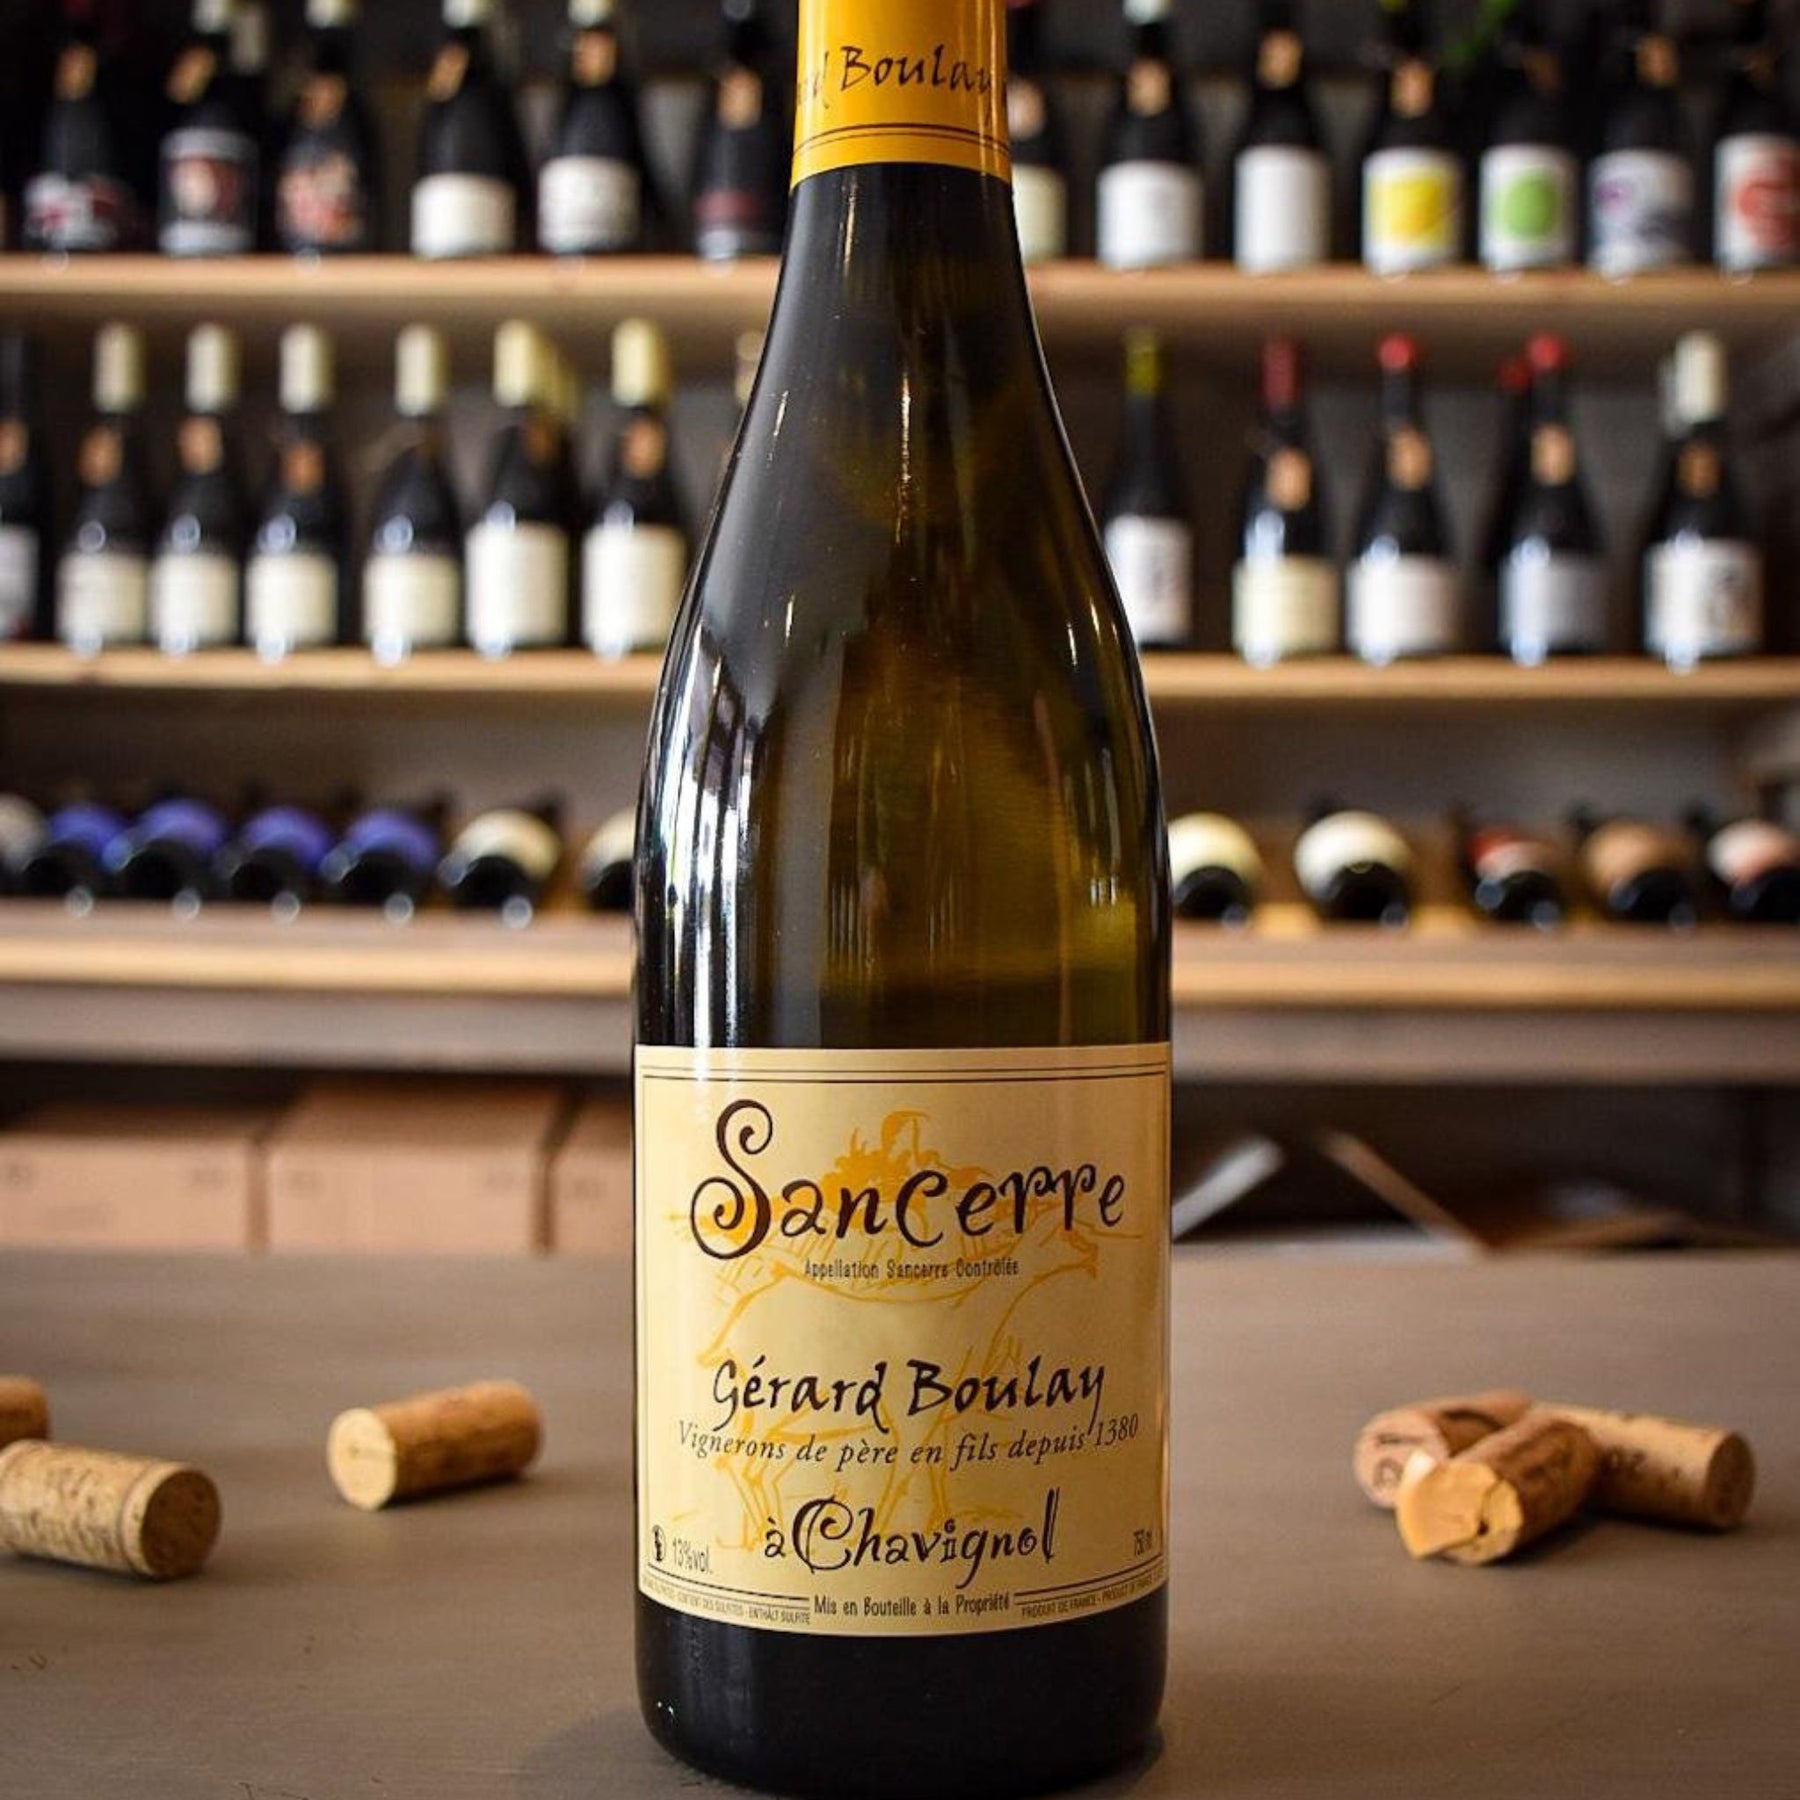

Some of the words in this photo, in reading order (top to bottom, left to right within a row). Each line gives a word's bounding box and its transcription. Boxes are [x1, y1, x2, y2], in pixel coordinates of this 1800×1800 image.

[690, 1098, 1125, 1260] Sancerre
[805, 1258, 879, 1280] Appellation
[887, 1258, 949, 1279] Sancerre
[713, 1354, 890, 1434] Gérard
[906, 1354, 1105, 1436] Boulay
[679, 1419, 790, 1459] Vignerons
[796, 1434, 828, 1462] de
[834, 1438, 898, 1472] père
[910, 1445, 942, 1464] en
[949, 1432, 998, 1471] fils
[1008, 1425, 1086, 1465] depuis
[1095, 1413, 1139, 1447] 1380
[764, 1516, 785, 1558] à
[791, 1487, 1061, 1590] Chavignol
[814, 1594, 837, 1615] Mis
[843, 1602, 858, 1616] en
[864, 1594, 917, 1617] Bouteille
[924, 1597, 931, 1615] à
[938, 1595, 949, 1615] la
[956, 1589, 1010, 1616] Propriété
